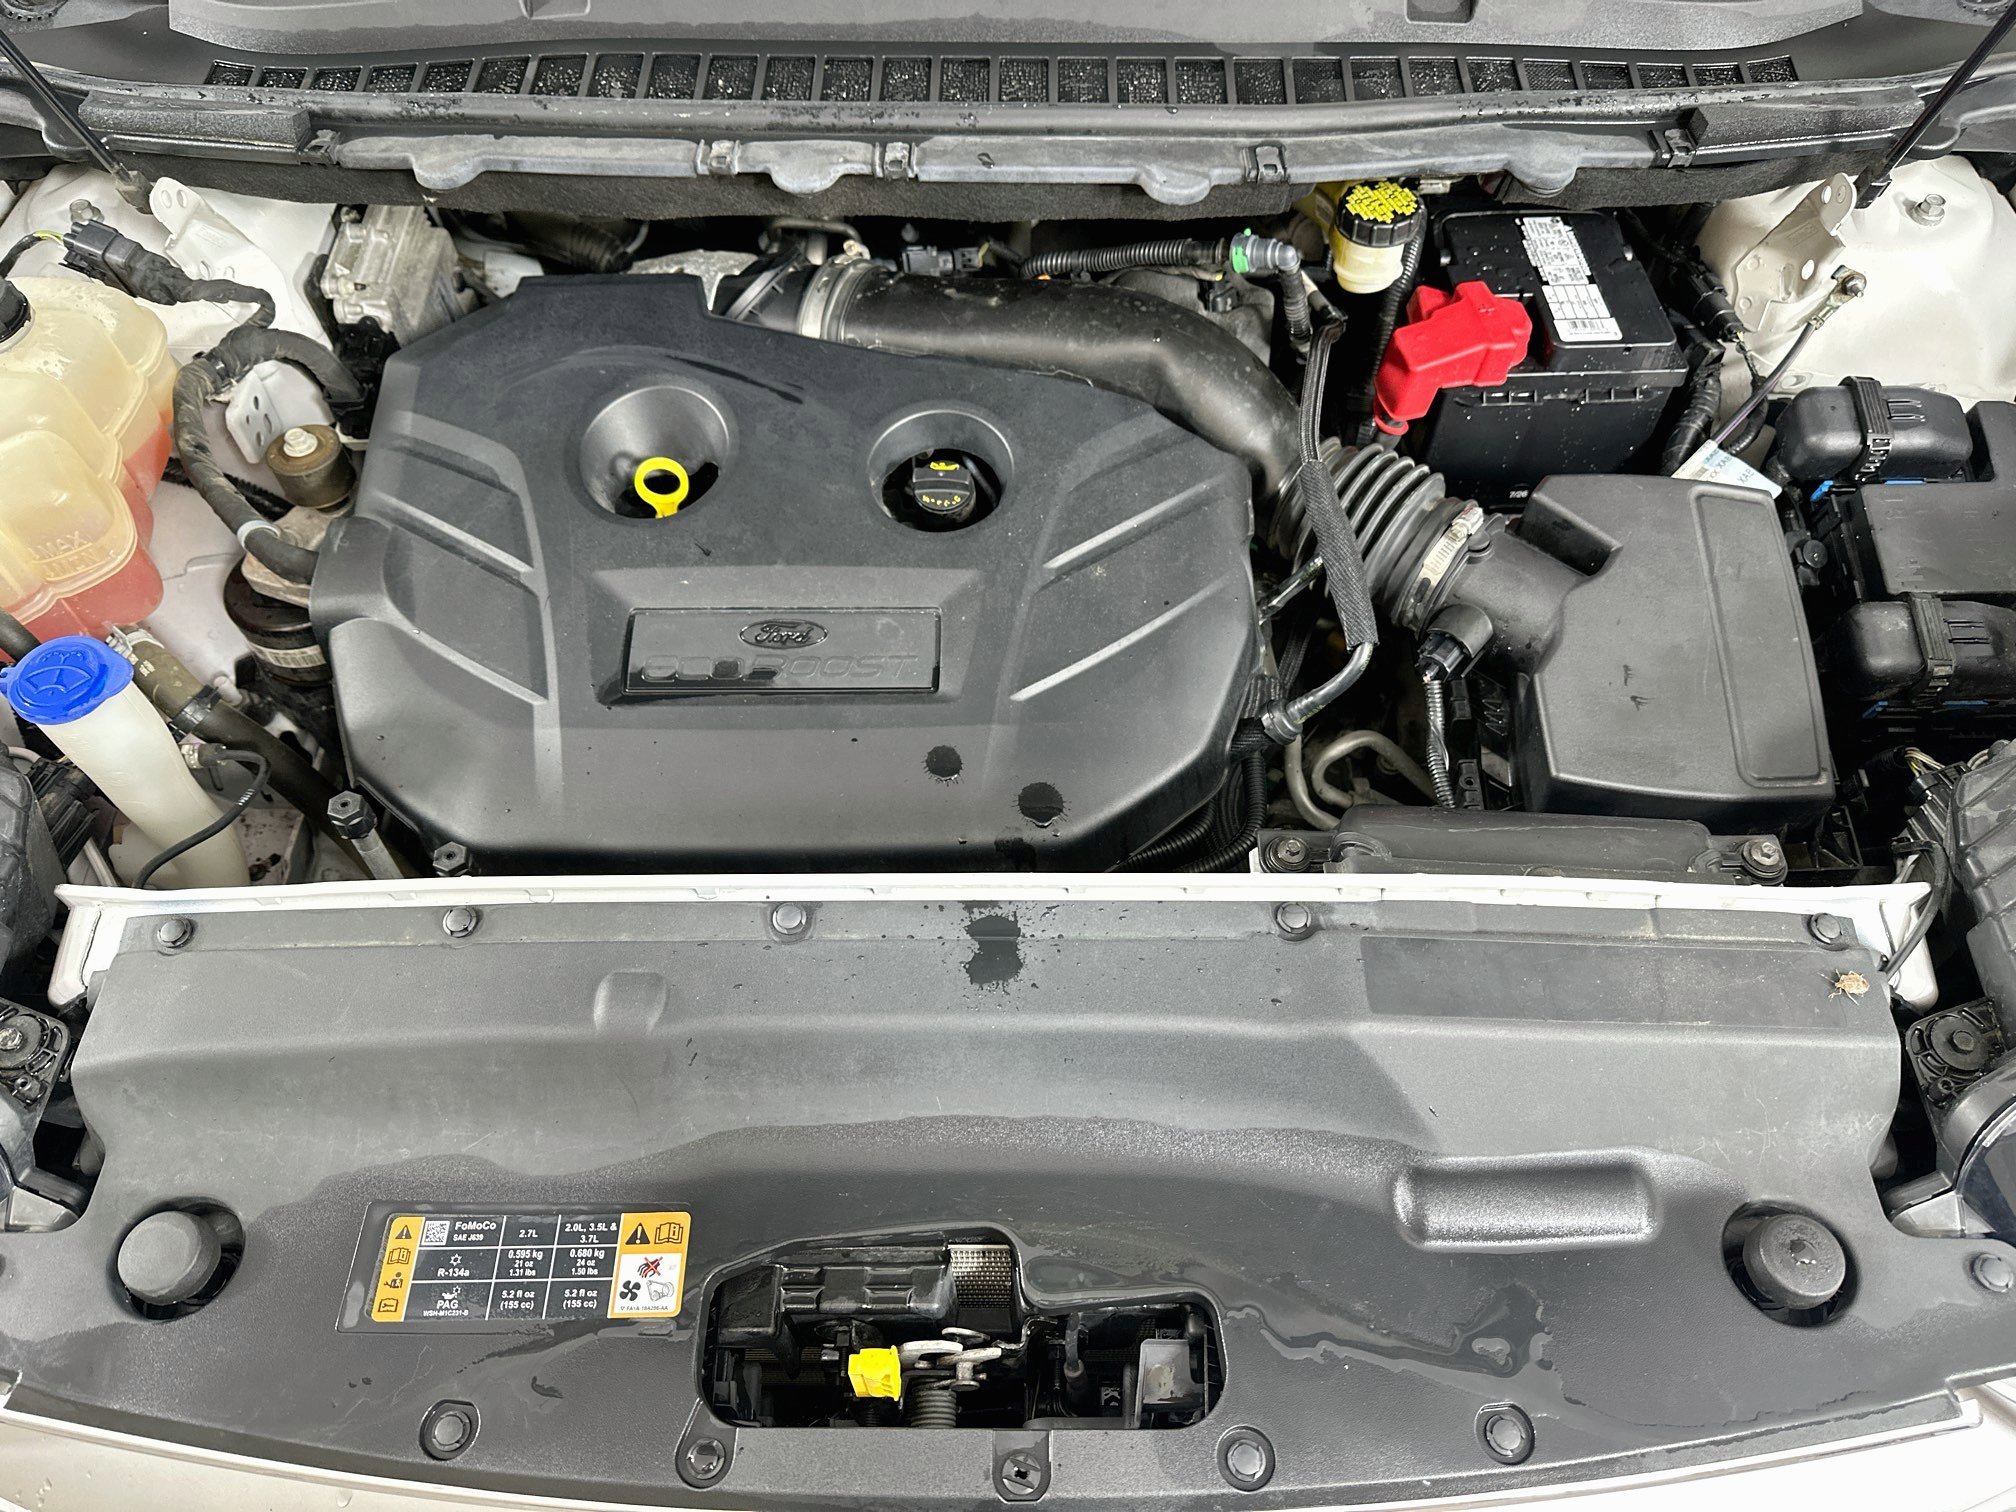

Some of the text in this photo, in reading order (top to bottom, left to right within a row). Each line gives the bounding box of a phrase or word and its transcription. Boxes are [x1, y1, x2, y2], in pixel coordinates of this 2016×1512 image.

[754, 620, 811, 644] Ford
[455, 1221, 497, 1231] FoMoCo
[565, 1222, 617, 1233] 2.0L, 3.5L &
[468, 1233, 483, 1241] J639
[519, 1229, 538, 1238] 2.7L
[580, 1235, 599, 1243] 3.7L
[508, 1249, 543, 1260] 0.595 kg
[569, 1249, 605, 1260] 0.680 kg
[576, 1258, 585, 1266] 24
[437, 1268, 470, 1277] R-134a
[524, 1268, 536, 1276] lbs
[587, 1267, 598, 1275] lbs
[502, 1290, 515, 1298] 5.2
[516, 1290, 523, 1298] fl
[564, 1289, 577, 1297] 5.2
[579, 1289, 585, 1297] fl
[437, 1300, 458, 1309] PAG
[500, 1300, 534, 1310] (155 cc)
[563, 1299, 597, 1309] (155 cc)
